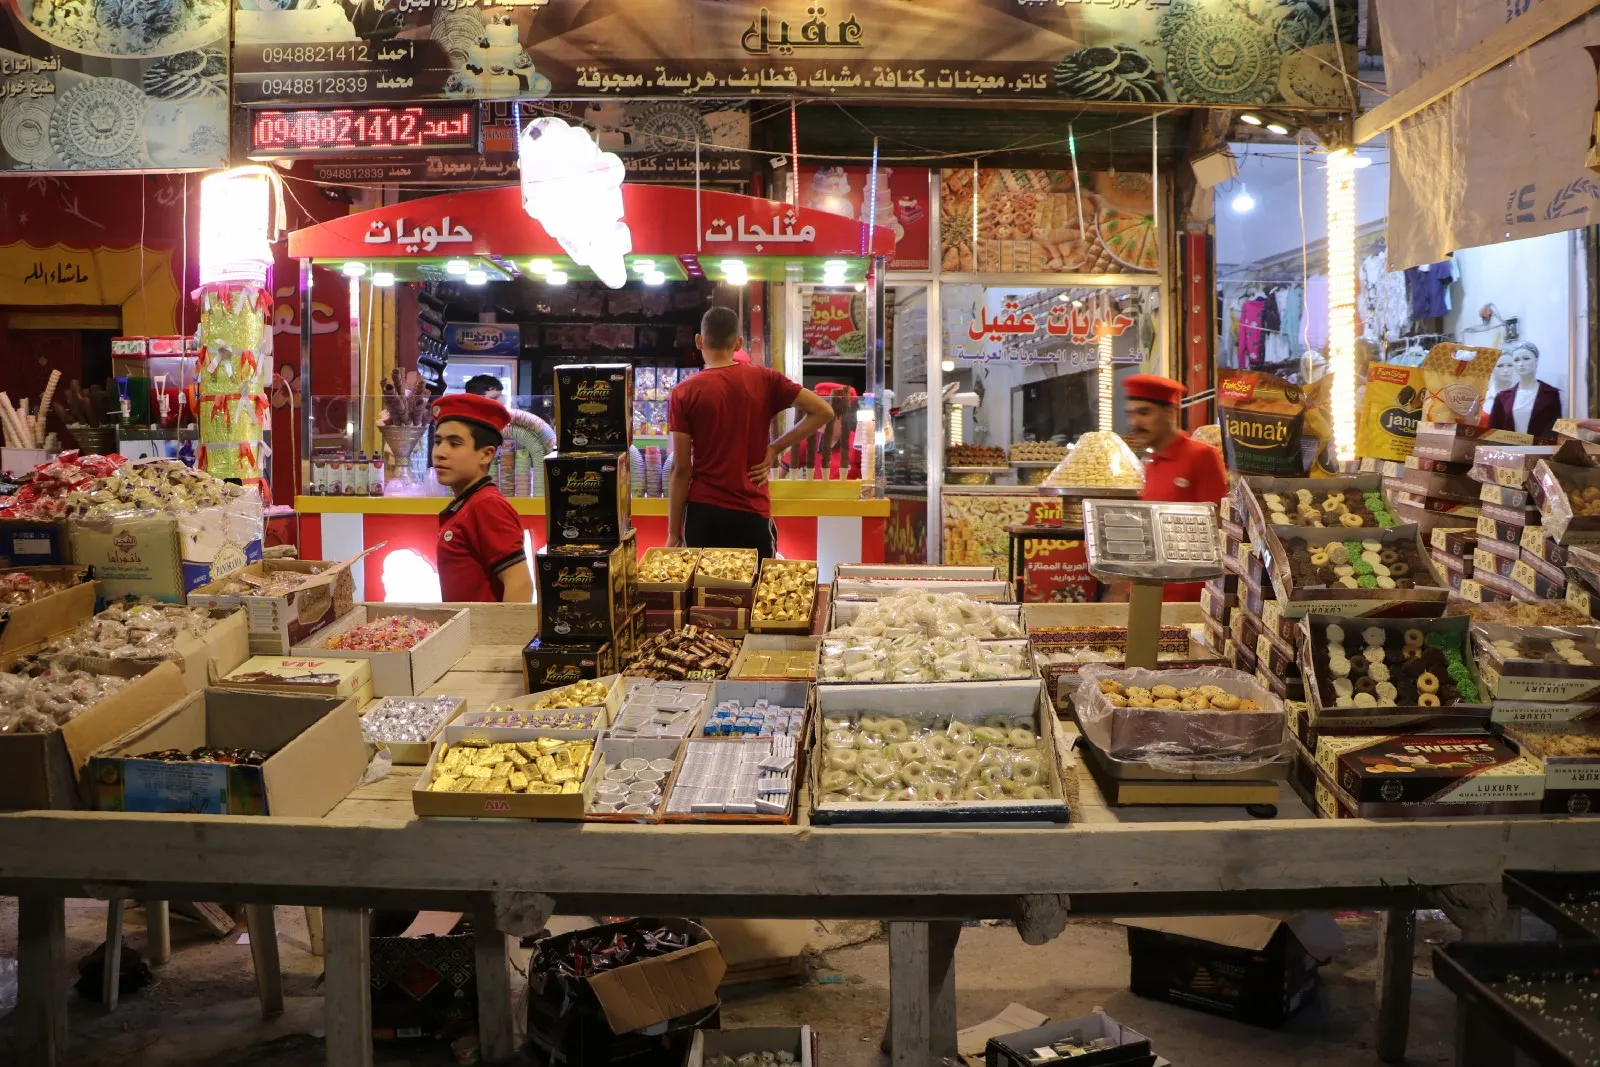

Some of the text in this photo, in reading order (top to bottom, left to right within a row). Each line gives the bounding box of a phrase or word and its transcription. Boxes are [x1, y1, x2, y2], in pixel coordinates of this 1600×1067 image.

[741, 7, 864, 55] عقيل
[262, 45, 368, 63] 0948821412
[262, 74, 414, 95] محمد 0948812839
[655, 66, 716, 94] هريسة
[728, 66, 798, 94] قطايف
[809, 66, 862, 93] مشبك
[873, 67, 926, 88] كنافة
[937, 69, 1006, 94] معجنات
[1016, 73, 1048, 92] كاتو
[255, 114, 417, 147] 0948821412
[319, 168, 385, 180] 0948812839
[364, 216, 473, 253] حلويات
[705, 209, 817, 253] مثلجات
[967, 300, 1134, 345] حلويات عقيل
[1386, 412, 1418, 428] jann
[1524, 686, 1566, 694] LUXURY
[1403, 743, 1496, 754] SWEETS
[1571, 773, 1600, 781] XURY
[1477, 784, 1520, 792] LUXURY
